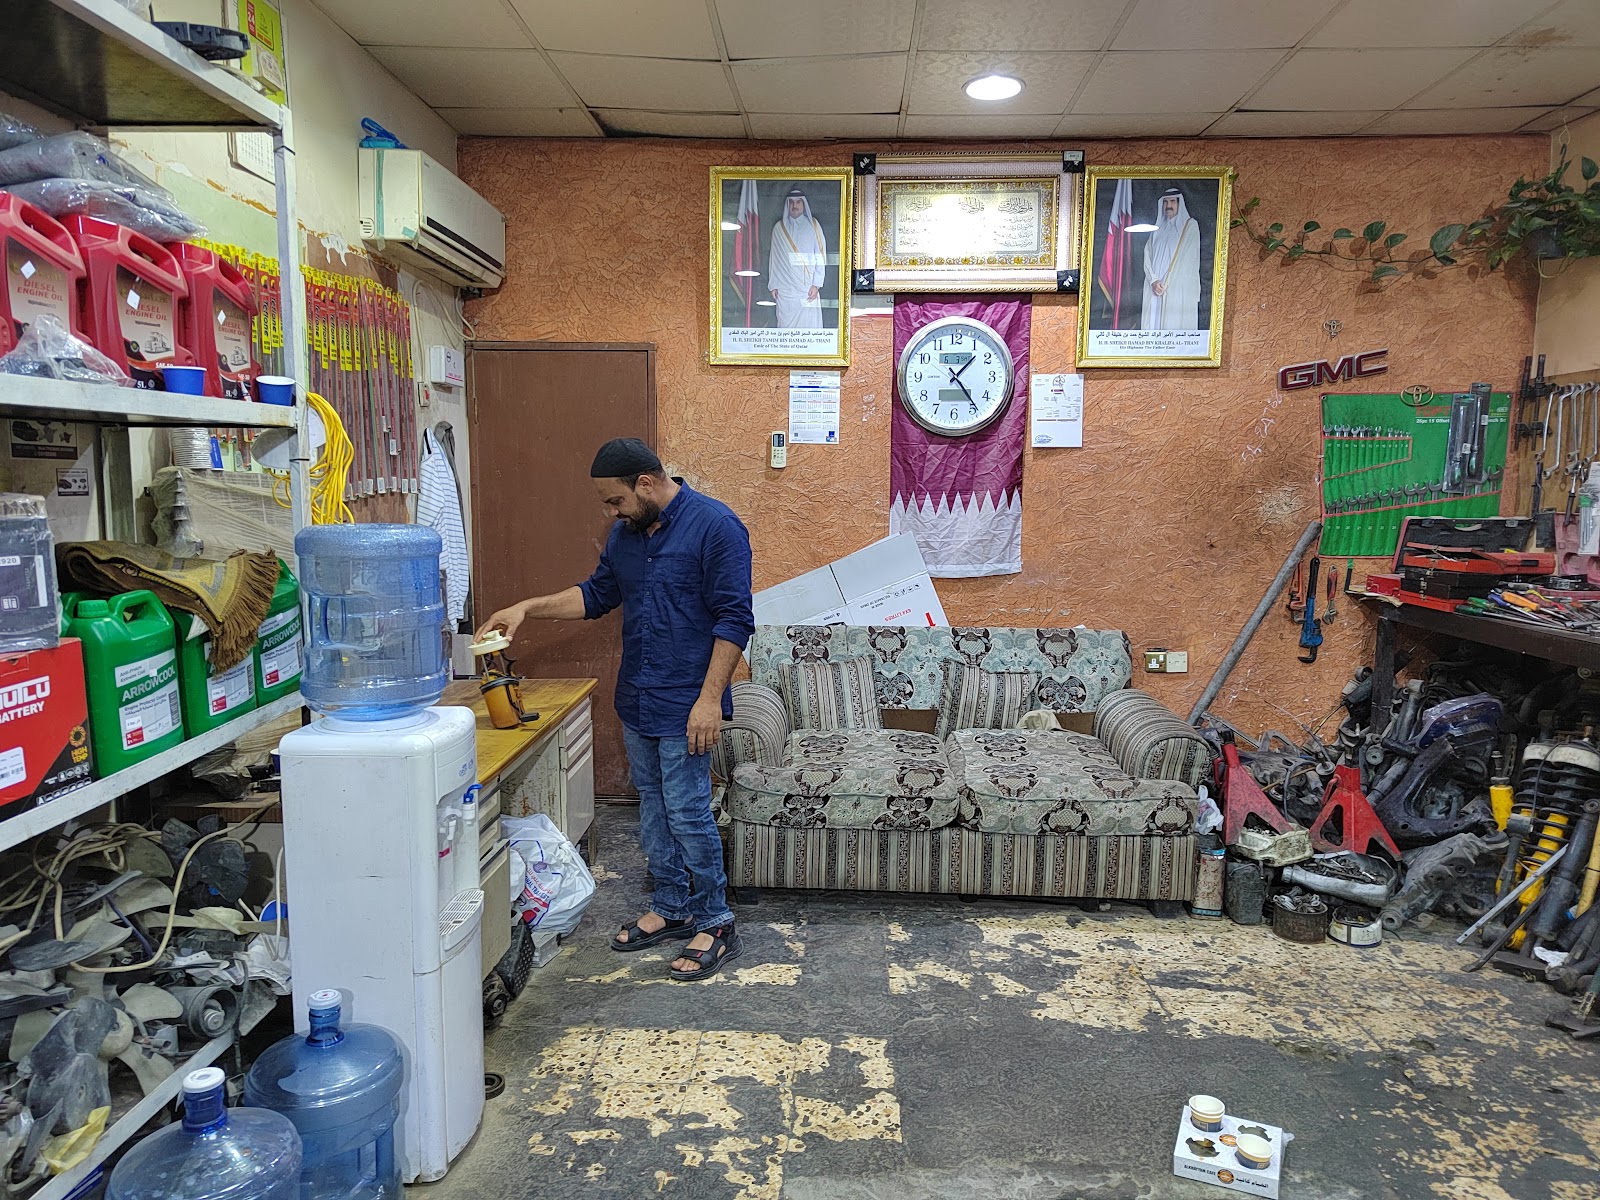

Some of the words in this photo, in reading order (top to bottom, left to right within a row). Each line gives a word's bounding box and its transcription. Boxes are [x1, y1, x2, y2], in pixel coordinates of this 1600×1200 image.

[24, 280, 56, 292] DIESEL
[16, 286, 49, 298] ENGINE
[51, 294, 64, 302] OIL
[126, 309, 154, 319] ENGINE
[218, 326, 236, 334] ENGINE
[933, 339, 943, 351] 11
[950, 333, 963, 345] 12
[972, 339, 977, 351] 1
[920, 353, 930, 364] 10
[984, 352, 992, 364] 2
[1278, 349, 1389, 391] GMC
[914, 371, 922, 383] 9
[988, 370, 996, 383] 3
[137, 380, 146, 389] 5L
[920, 390, 928, 402] 8
[982, 390, 991, 402] 4
[932, 403, 940, 414] 7
[950, 408, 958, 420] 6
[968, 403, 977, 416] 5
[262, 618, 300, 650] ARROWCOOL
[122, 664, 176, 702] ARROWCOOL
[71, 745, 88, 758] HIGH
[72, 752, 88, 764] TEMP
